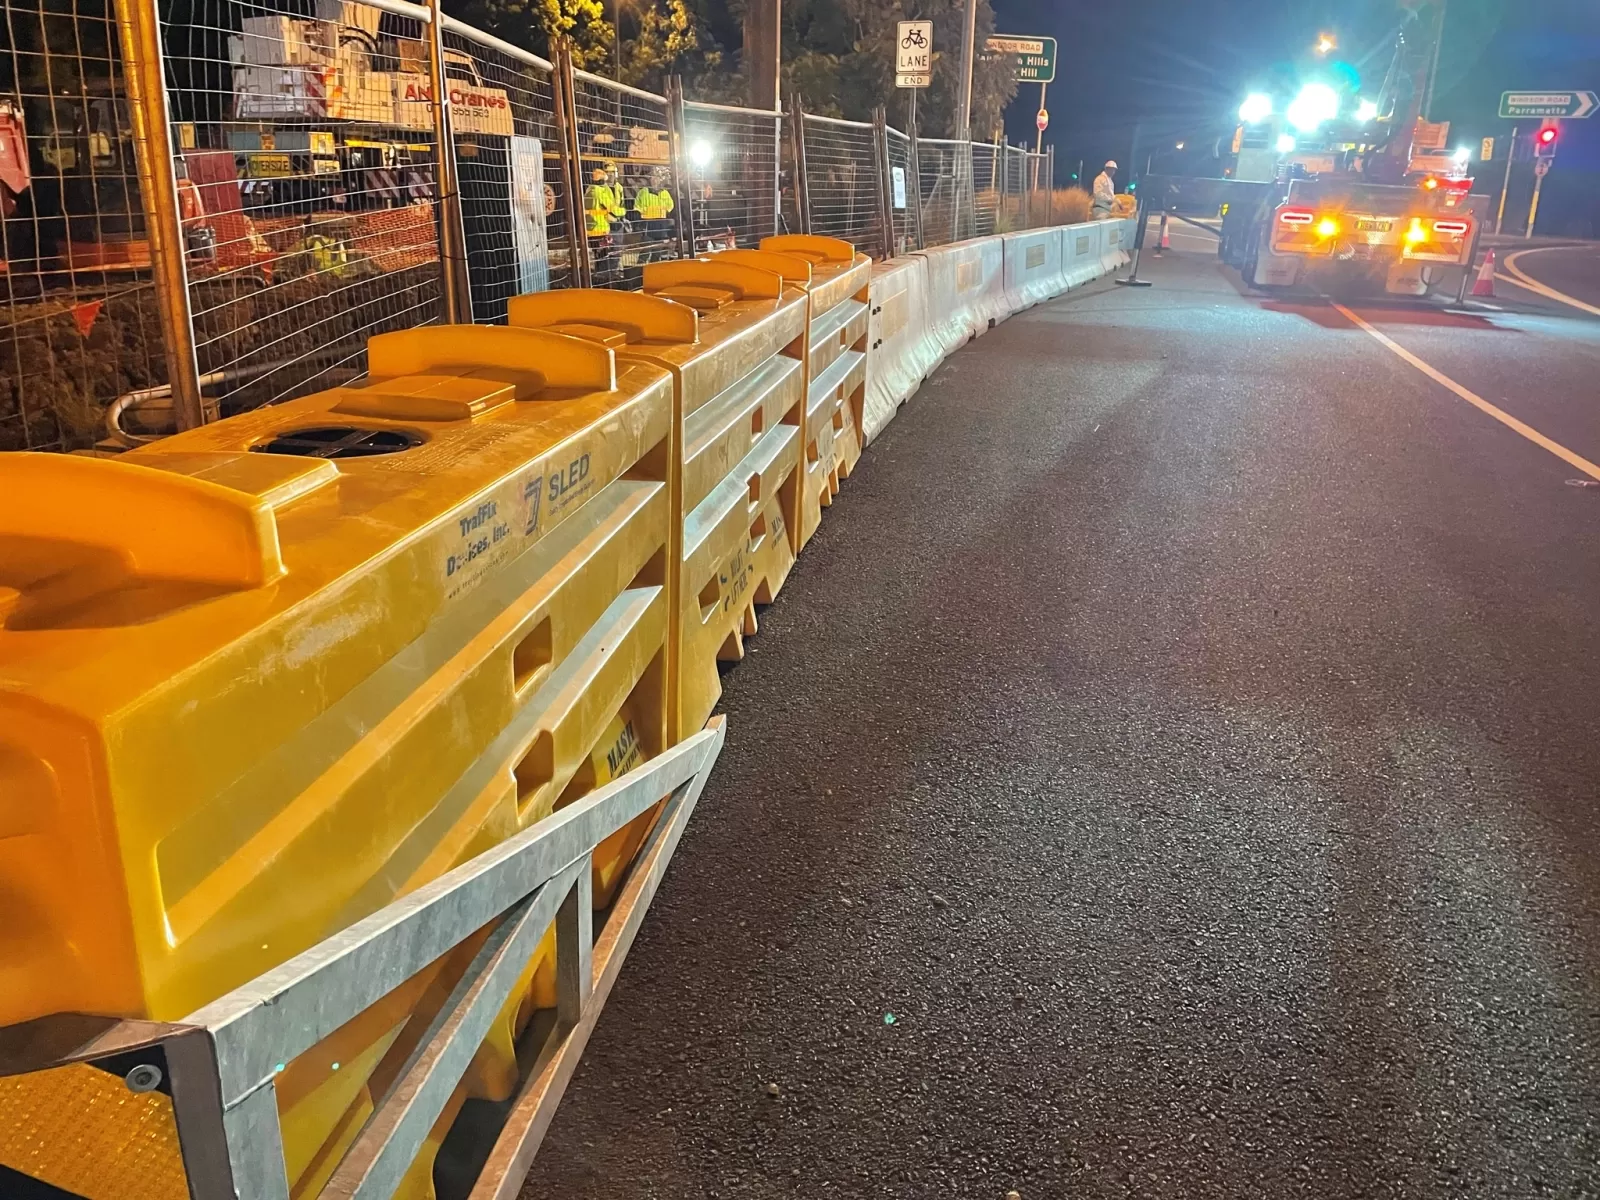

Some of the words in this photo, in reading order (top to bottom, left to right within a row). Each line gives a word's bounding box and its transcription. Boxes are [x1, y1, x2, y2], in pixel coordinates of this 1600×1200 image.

[1020, 43, 1041, 51] ROAD
[900, 55, 928, 67] LANE
[1027, 56, 1049, 67] Hills
[1020, 68, 1038, 77] Hill
[904, 76, 922, 84] END
[449, 88, 507, 109] Cranes
[1508, 106, 1567, 115] Parramatta
[251, 160, 289, 169] OERSIZE
[549, 454, 590, 501] SLED
